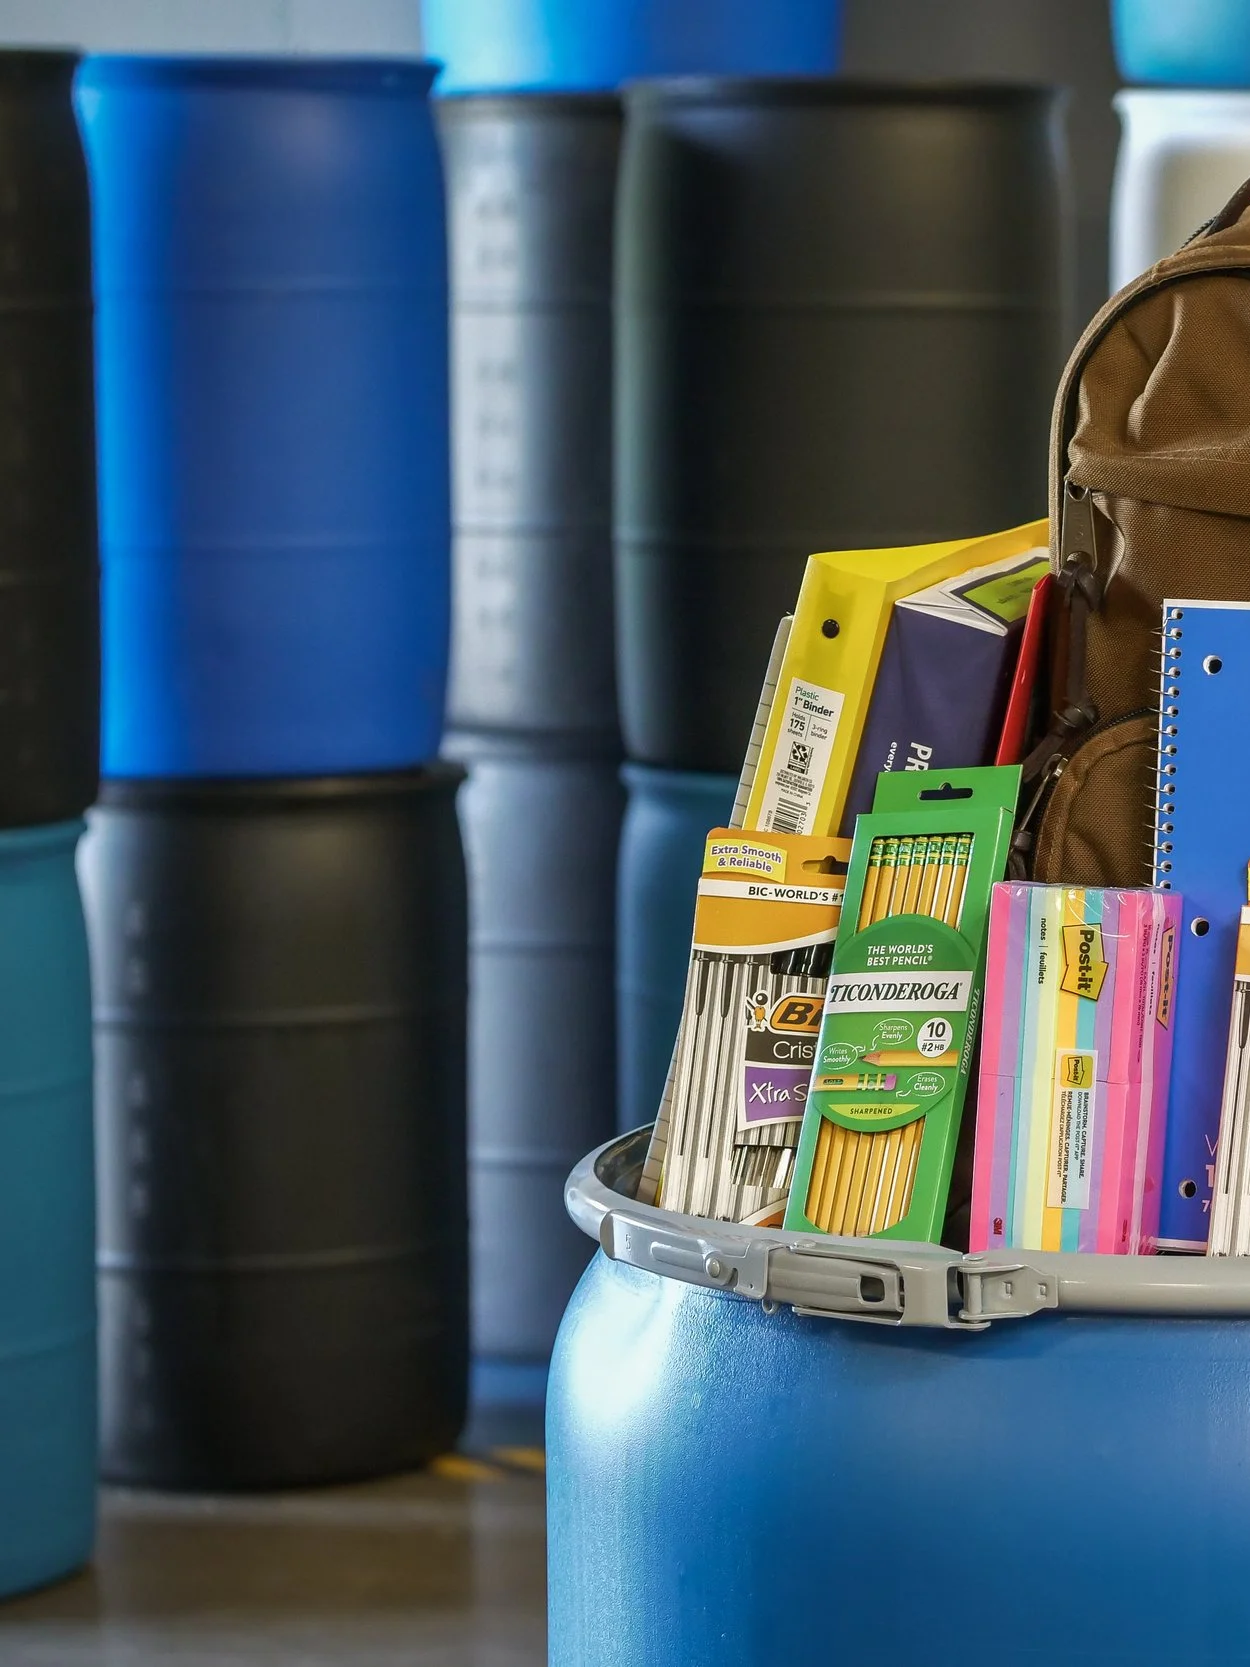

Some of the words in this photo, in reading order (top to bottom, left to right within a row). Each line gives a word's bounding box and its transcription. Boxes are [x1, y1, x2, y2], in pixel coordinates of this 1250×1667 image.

[795, 686, 819, 701] Plastic
[803, 700, 834, 717] Binder
[792, 711, 806, 721] Holds
[790, 718, 806, 731] 175
[787, 728, 803, 738] sheets
[810, 731, 828, 741] binder
[711, 845, 738, 856] Extra
[741, 845, 782, 864] Smooth
[718, 857, 727, 867] &
[729, 857, 772, 873] Reliable
[867, 945, 885, 955] THE
[888, 944, 934, 955] WORLD'S
[867, 956, 889, 967] BEST
[1038, 952, 1047, 985] feuillets
[829, 982, 960, 1004] TICONDEROGA
[879, 1023, 908, 1034] Sharpens
[927, 1021, 946, 1038] 10
[960, 988, 981, 1076] TICONDEROGA
[881, 1031, 903, 1041] Evenly
[773, 1041, 818, 1058] Cris
[829, 1047, 848, 1056] Writes
[921, 1042, 933, 1052] #2
[823, 1055, 852, 1065] Smoothly
[917, 1075, 938, 1083] Erases
[749, 1081, 791, 1104] Xtra
[913, 1083, 939, 1093] Cleanly
[850, 1107, 893, 1115] SHARPENED
